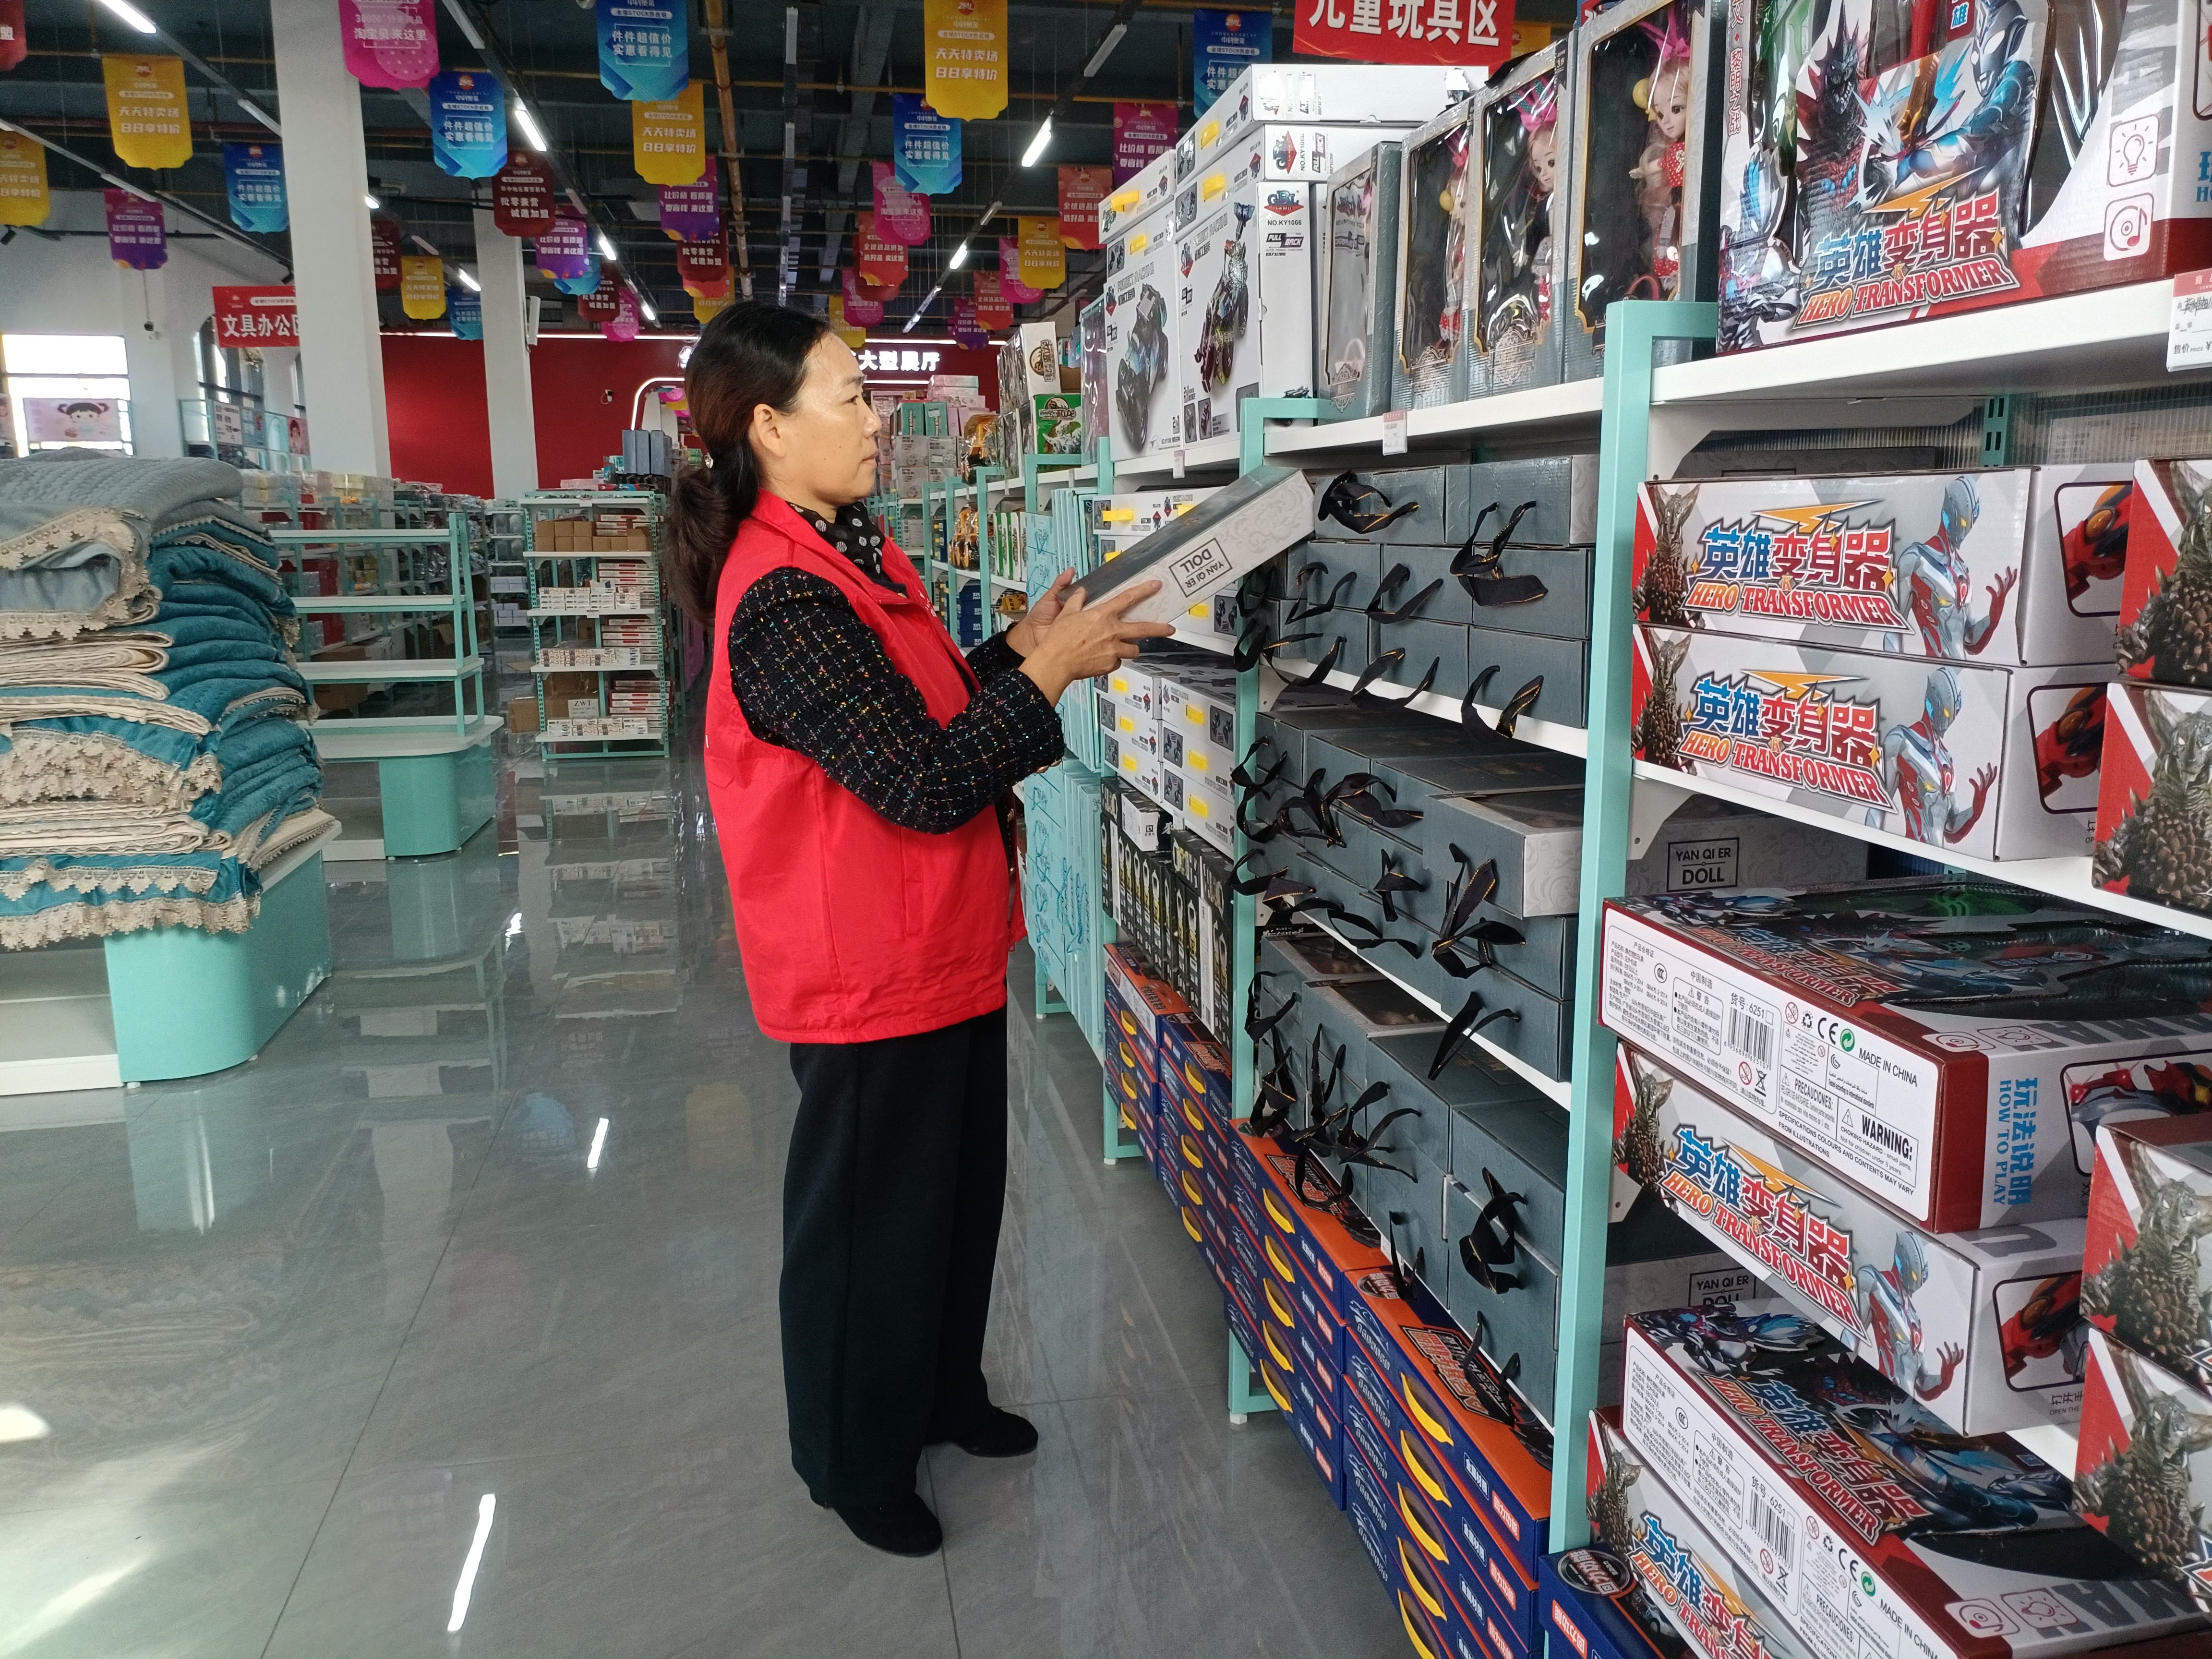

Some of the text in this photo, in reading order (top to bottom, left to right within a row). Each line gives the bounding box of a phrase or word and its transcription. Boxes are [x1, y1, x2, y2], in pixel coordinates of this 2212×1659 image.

[613, 31, 671, 44] 件件超值价
[613, 45, 672, 58] 实惠看得见
[936, 48, 998, 62] 天天特卖场
[936, 67, 998, 81] 日日享特价
[643, 127, 696, 138] 天天特卖场
[643, 143, 696, 153] 日日享特价
[905, 140, 950, 150] 件件超值价
[905, 150, 950, 160] 实惠看得见
[1285, 238, 1303, 246] BACK
[1815, 192, 2002, 288] 英雄变身器
[1803, 258, 2008, 324] HERO TRANSFORMER
[858, 350, 940, 372] 大型展厅
[2174, 343, 2189, 354] 售价
[1179, 548, 1213, 573] DOLL
[1206, 560, 1224, 576] YAN
[1693, 525, 1892, 592] 英雄变身器
[1185, 577, 1197, 589] ER
[1685, 583, 1901, 626] HERO TRANSFORMER
[1683, 678, 1875, 765] 英雄变身器
[1680, 732, 1886, 805] HERO TRANSFORMER
[1676, 846, 1731, 861] YAN QI ER
[1682, 867, 1725, 885] DOLL
[1690, 928, 1855, 1006] HERO TRANSFORMER
[1691, 971, 1713, 989] 中国制造
[1704, 996, 1709, 1005] 告
[1859, 1047, 1882, 1069] MADE
[1883, 1059, 1892, 1073] IN
[1892, 1065, 1918, 1087] CHINA
[1795, 1078, 1833, 1111] PRECAUCIONES:
[1779, 1121, 1831, 1159] FROM ILLUSTRATIONS.
[1779, 1110, 1914, 1196] SPECIFICATIONS COLOURS AND CONTENTS MAY VARY
[1840, 1126, 1863, 1143] CHOKING
[1863, 1140, 1884, 1154] HAZARD
[1854, 1142, 1871, 1157] children
[1872, 1152, 1885, 1164] under
[1862, 1114, 1913, 1161] WARNING:
[1993, 1080, 2012, 1206] HOW TO PLAY
[2008, 1077, 2038, 1206] 玩法说明
[1666, 1129, 1852, 1291] 英雄变身器
[1663, 1171, 1857, 1331] HERO TRANSFORMER
[1697, 1274, 1749, 1291] YAN QI ER
[1707, 1376, 1765, 1415] HERO
[1751, 1417, 1875, 1536] TRANSFORMER
[1747, 1380, 1930, 1522] 英雄变身器
[1493, 1497, 1518, 1537] 回力功能
[1632, 1551, 1677, 1604] HERO
[1554, 1605, 1585, 1655] 回力功能
[1880, 1599, 1938, 1659] MADE IN CHIN
